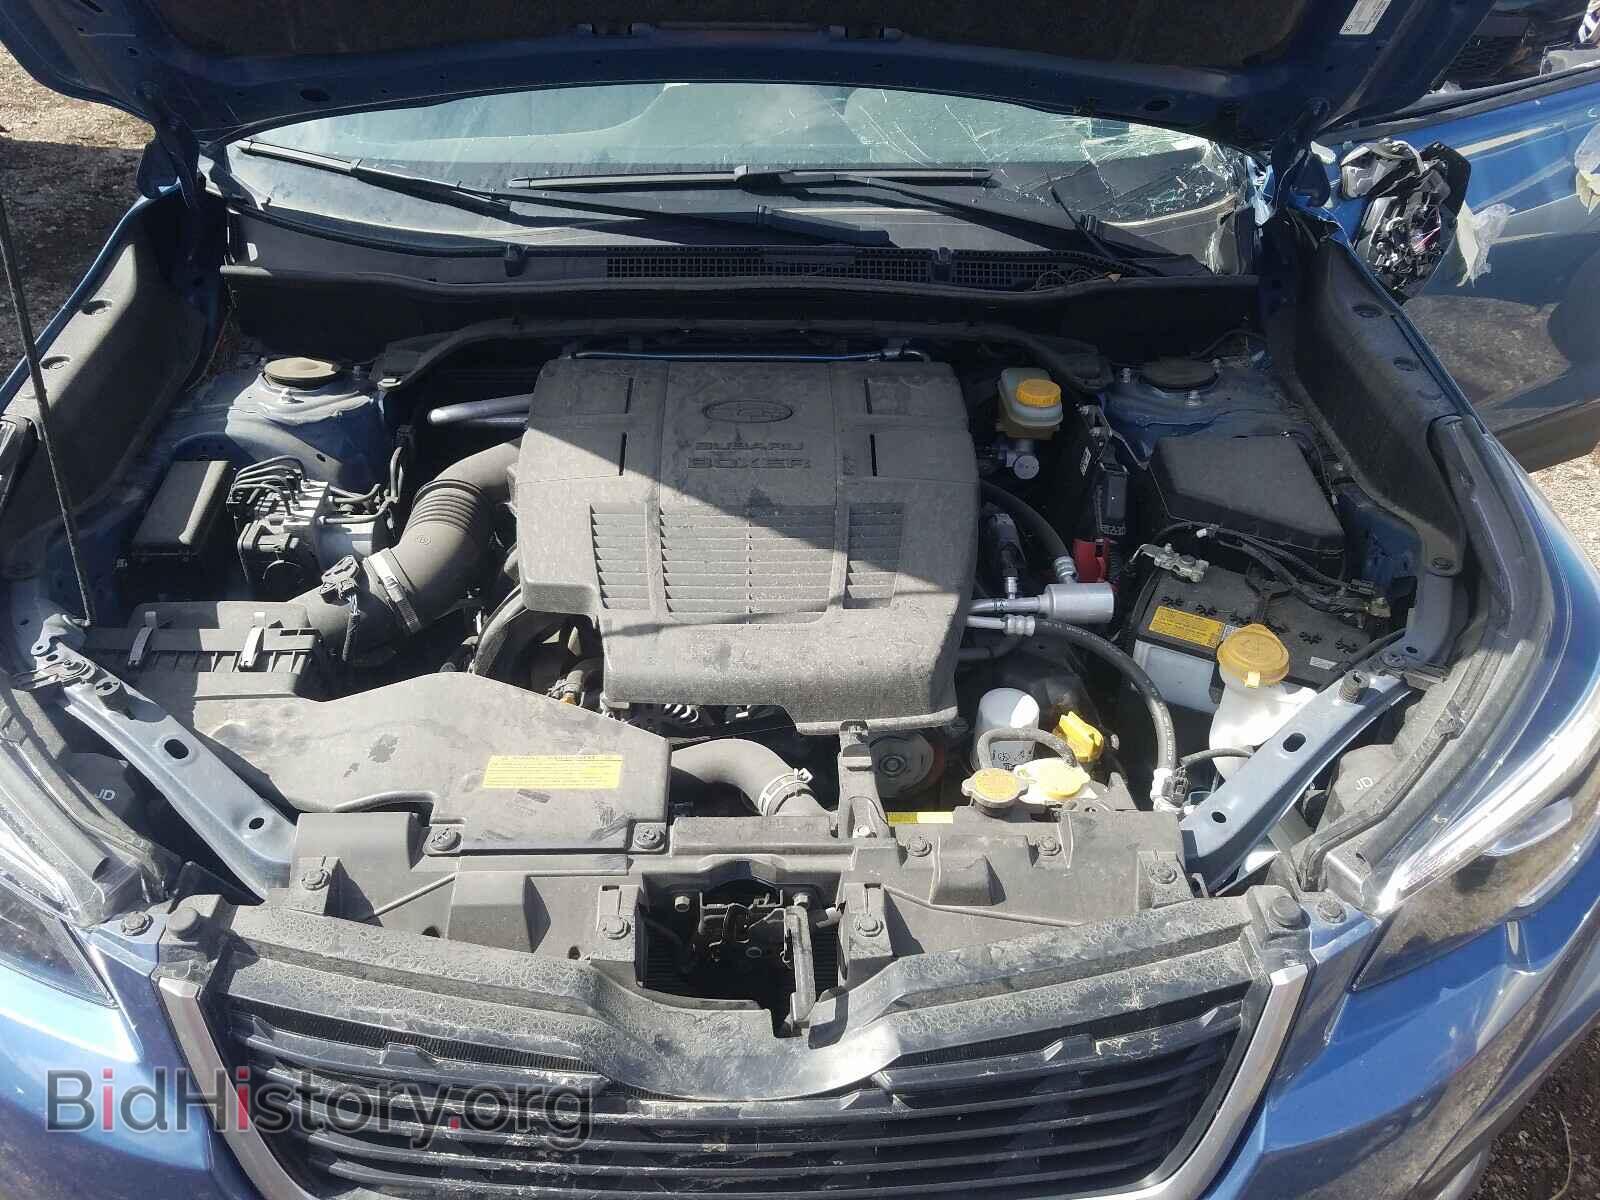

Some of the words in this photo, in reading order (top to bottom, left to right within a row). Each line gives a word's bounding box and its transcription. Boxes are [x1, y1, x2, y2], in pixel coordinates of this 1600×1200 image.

[695, 441, 805, 451] SUBARU
[687, 456, 812, 469] BOXER
[95, 788, 116, 801] JD
